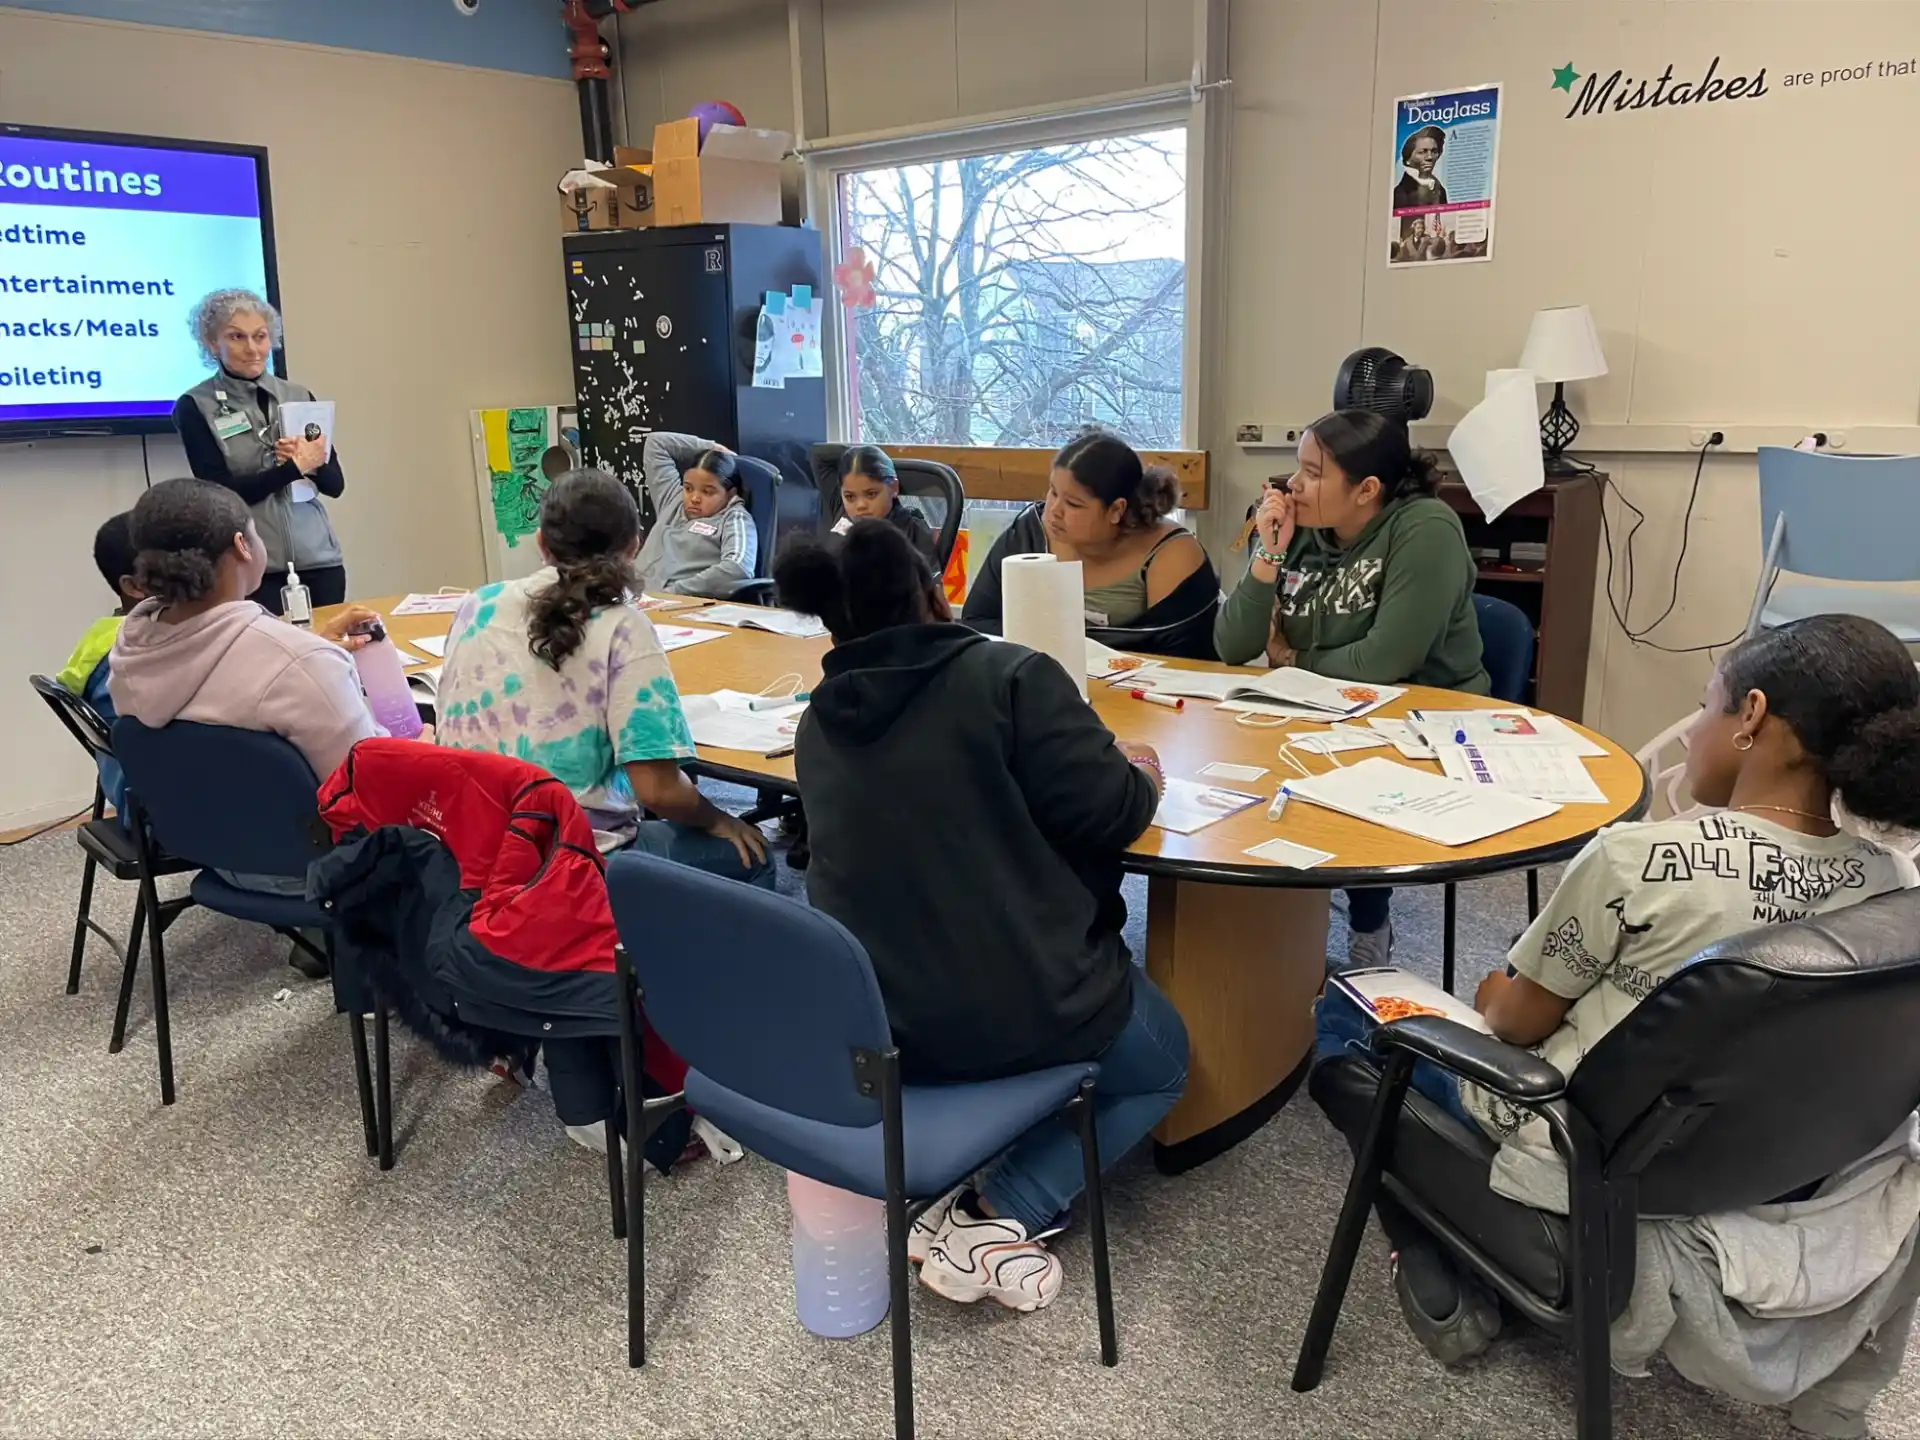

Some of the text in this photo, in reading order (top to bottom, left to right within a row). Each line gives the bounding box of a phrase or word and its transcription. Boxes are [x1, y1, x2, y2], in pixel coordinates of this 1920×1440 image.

[1565, 56, 1917, 119] Mistakes are proof that
[1407, 101, 1491, 124] Douglass
[0, 224, 86, 246] dtime
[705, 249, 722, 272] R
[0, 366, 102, 389] oileting
[1642, 841, 1739, 882] ALL
